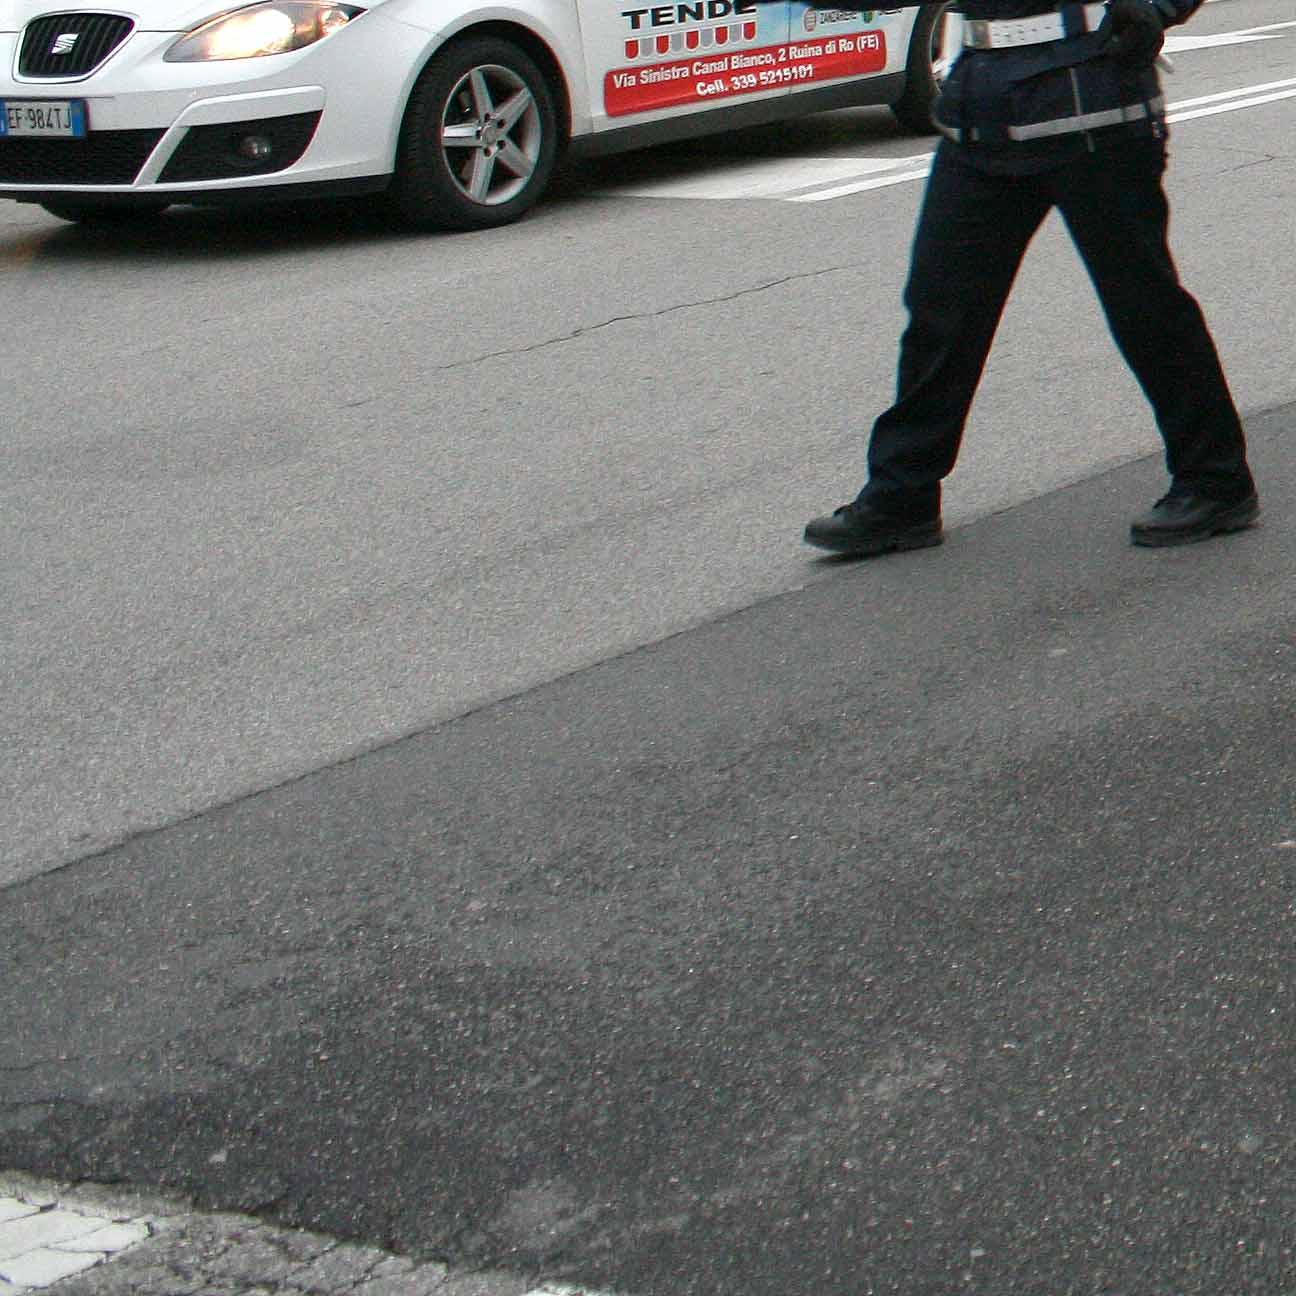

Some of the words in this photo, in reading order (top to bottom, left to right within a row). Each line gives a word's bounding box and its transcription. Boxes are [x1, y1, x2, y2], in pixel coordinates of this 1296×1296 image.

[613, 71, 637, 89] Via
[639, 66, 690, 85] Sinistra
[692, 59, 729, 76] Canal
[730, 54, 777, 71] Bianco,
[778, 48, 786, 63] 2
[789, 44, 823, 60] Ruina
[825, 41, 836, 55] di
[838, 38, 854, 53] Ro
[856, 34, 880, 53] (FE)
[696, 77, 729, 97] Cell.
[731, 74, 757, 91] 339
[759, 64, 815, 84] 5215101
